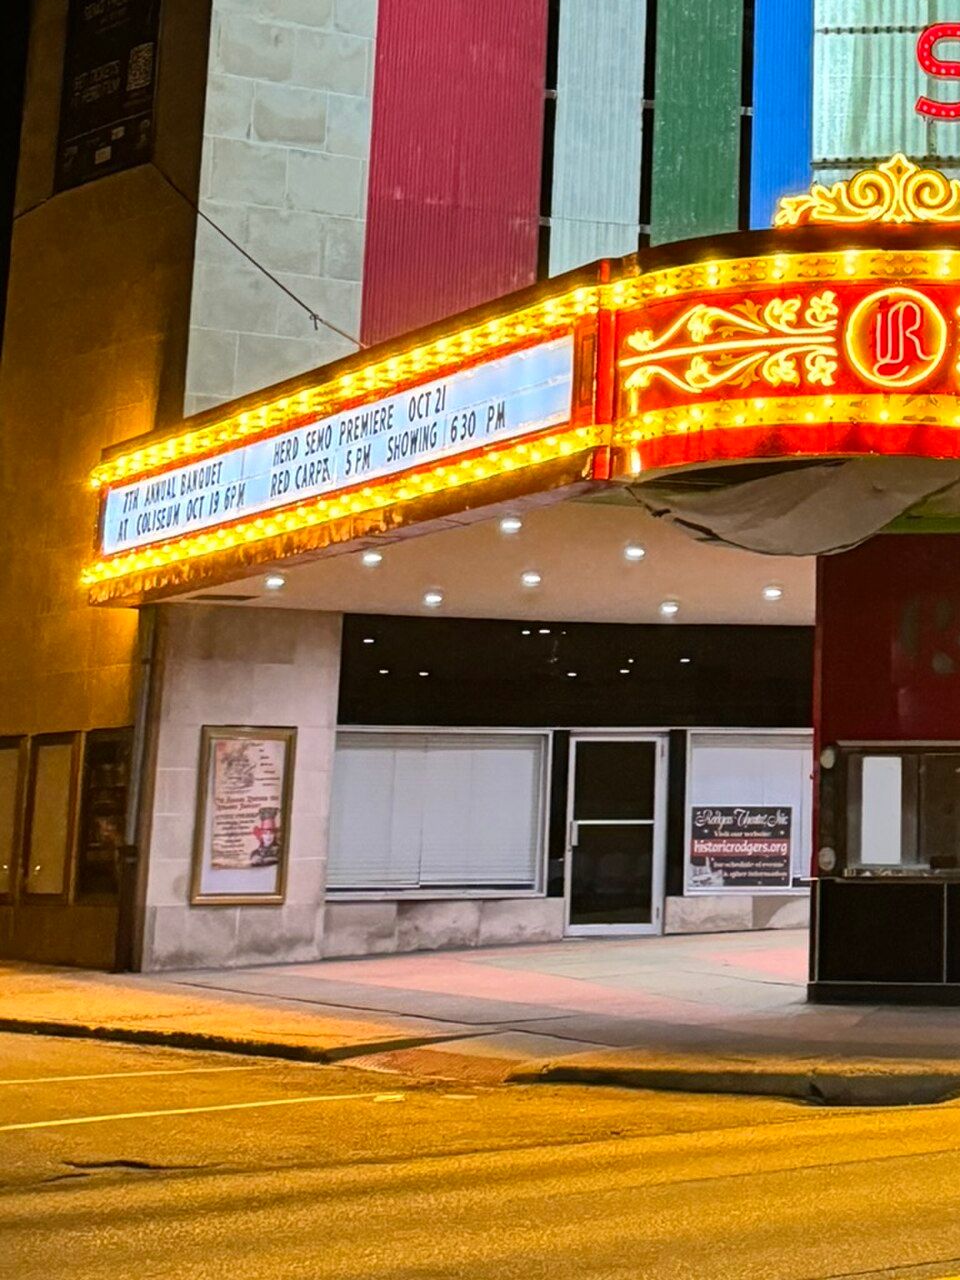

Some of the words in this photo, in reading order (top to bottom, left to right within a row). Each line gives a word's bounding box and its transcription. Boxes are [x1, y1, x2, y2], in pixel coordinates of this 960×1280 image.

[270, 469, 291, 498] RED
[386, 421, 438, 462] SHOWING
[486, 400, 505, 433] PM
[272, 436, 300, 467] HERD
[305, 424, 333, 457] SEMO
[338, 404, 395, 447] PREMIERE
[408, 391, 432, 422] OCT
[435, 385, 447, 414] 21
[122, 487, 140, 514] 7TH
[144, 476, 177, 507] ANNUAL
[180, 461, 223, 496] BANQUET
[117, 518, 129, 542] AT
[136, 502, 181, 536] COLISEUM
[186, 496, 205, 522] OCT
[209, 491, 220, 517] 19
[694, 840, 788, 856] historicrodgers.org
